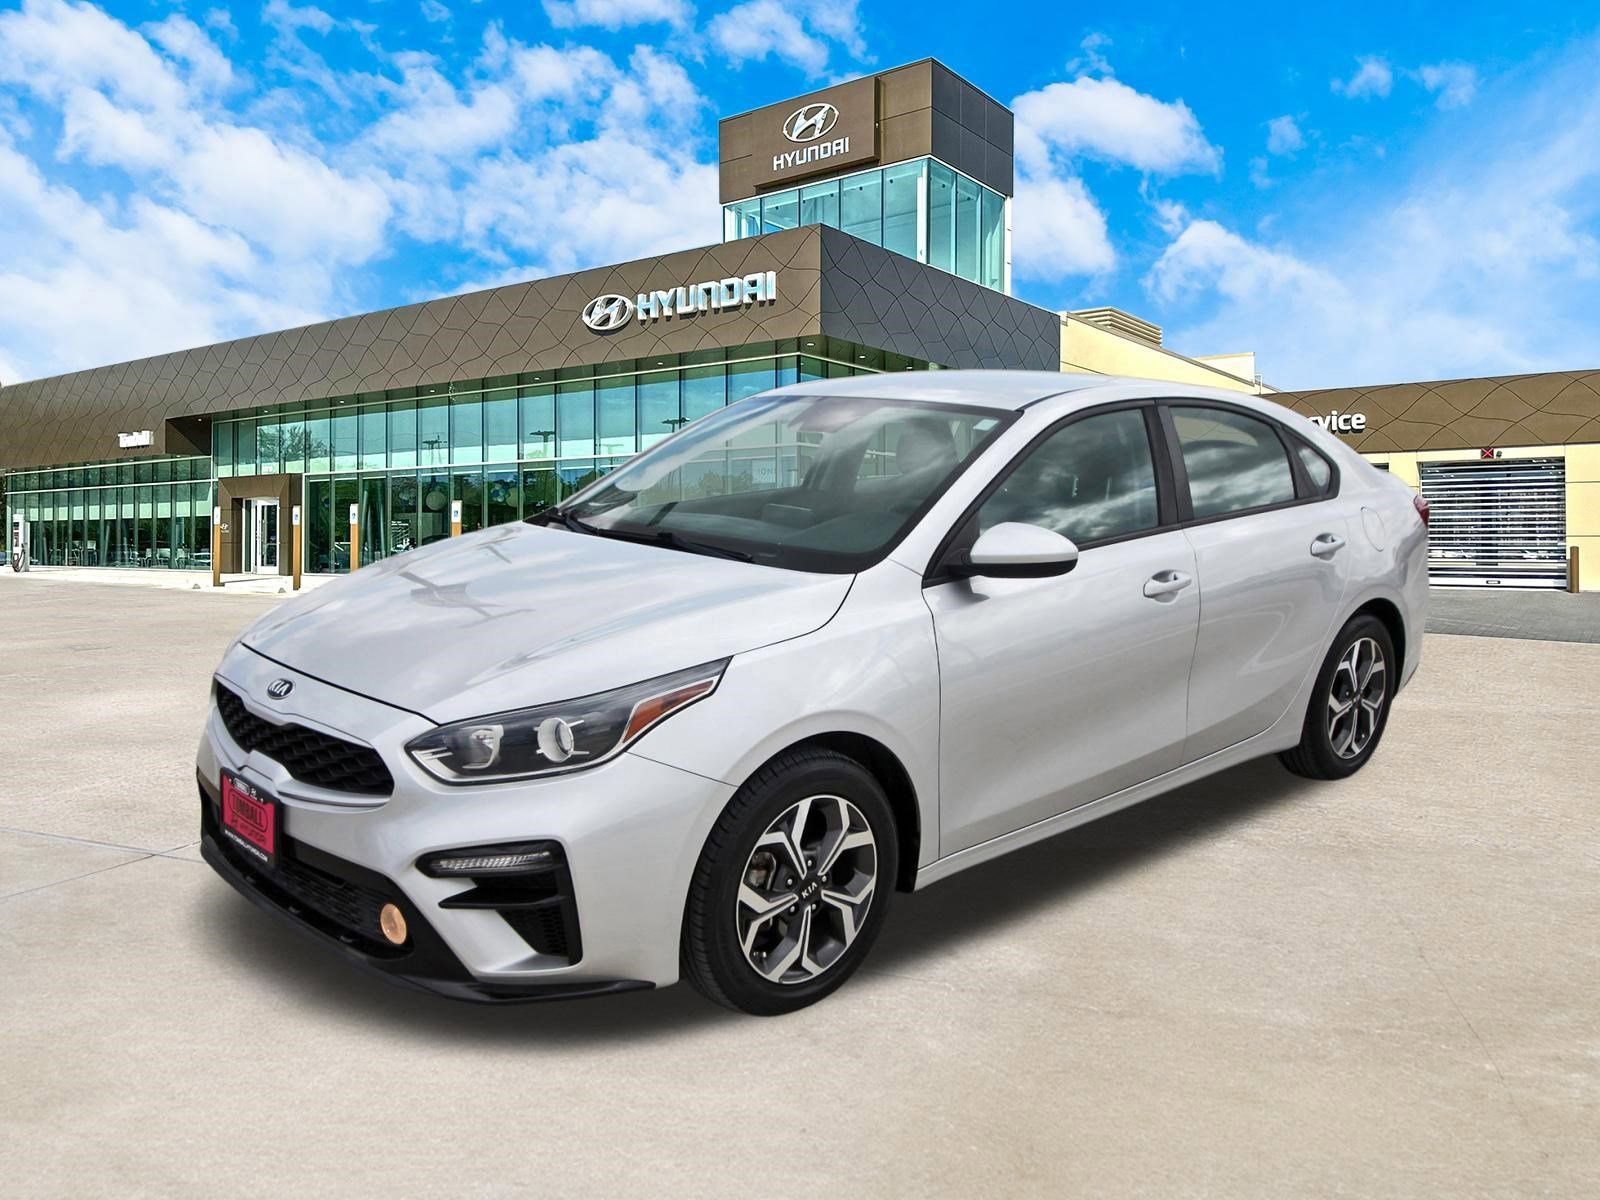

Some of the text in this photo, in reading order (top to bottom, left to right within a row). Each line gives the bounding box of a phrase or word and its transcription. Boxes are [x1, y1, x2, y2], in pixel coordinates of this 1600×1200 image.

[773, 136, 849, 171] HYUNDAI
[636, 270, 777, 321] HYUNDAI
[1309, 410, 1366, 430] vice
[269, 680, 291, 696] KIA
[802, 882, 818, 898] KIA
